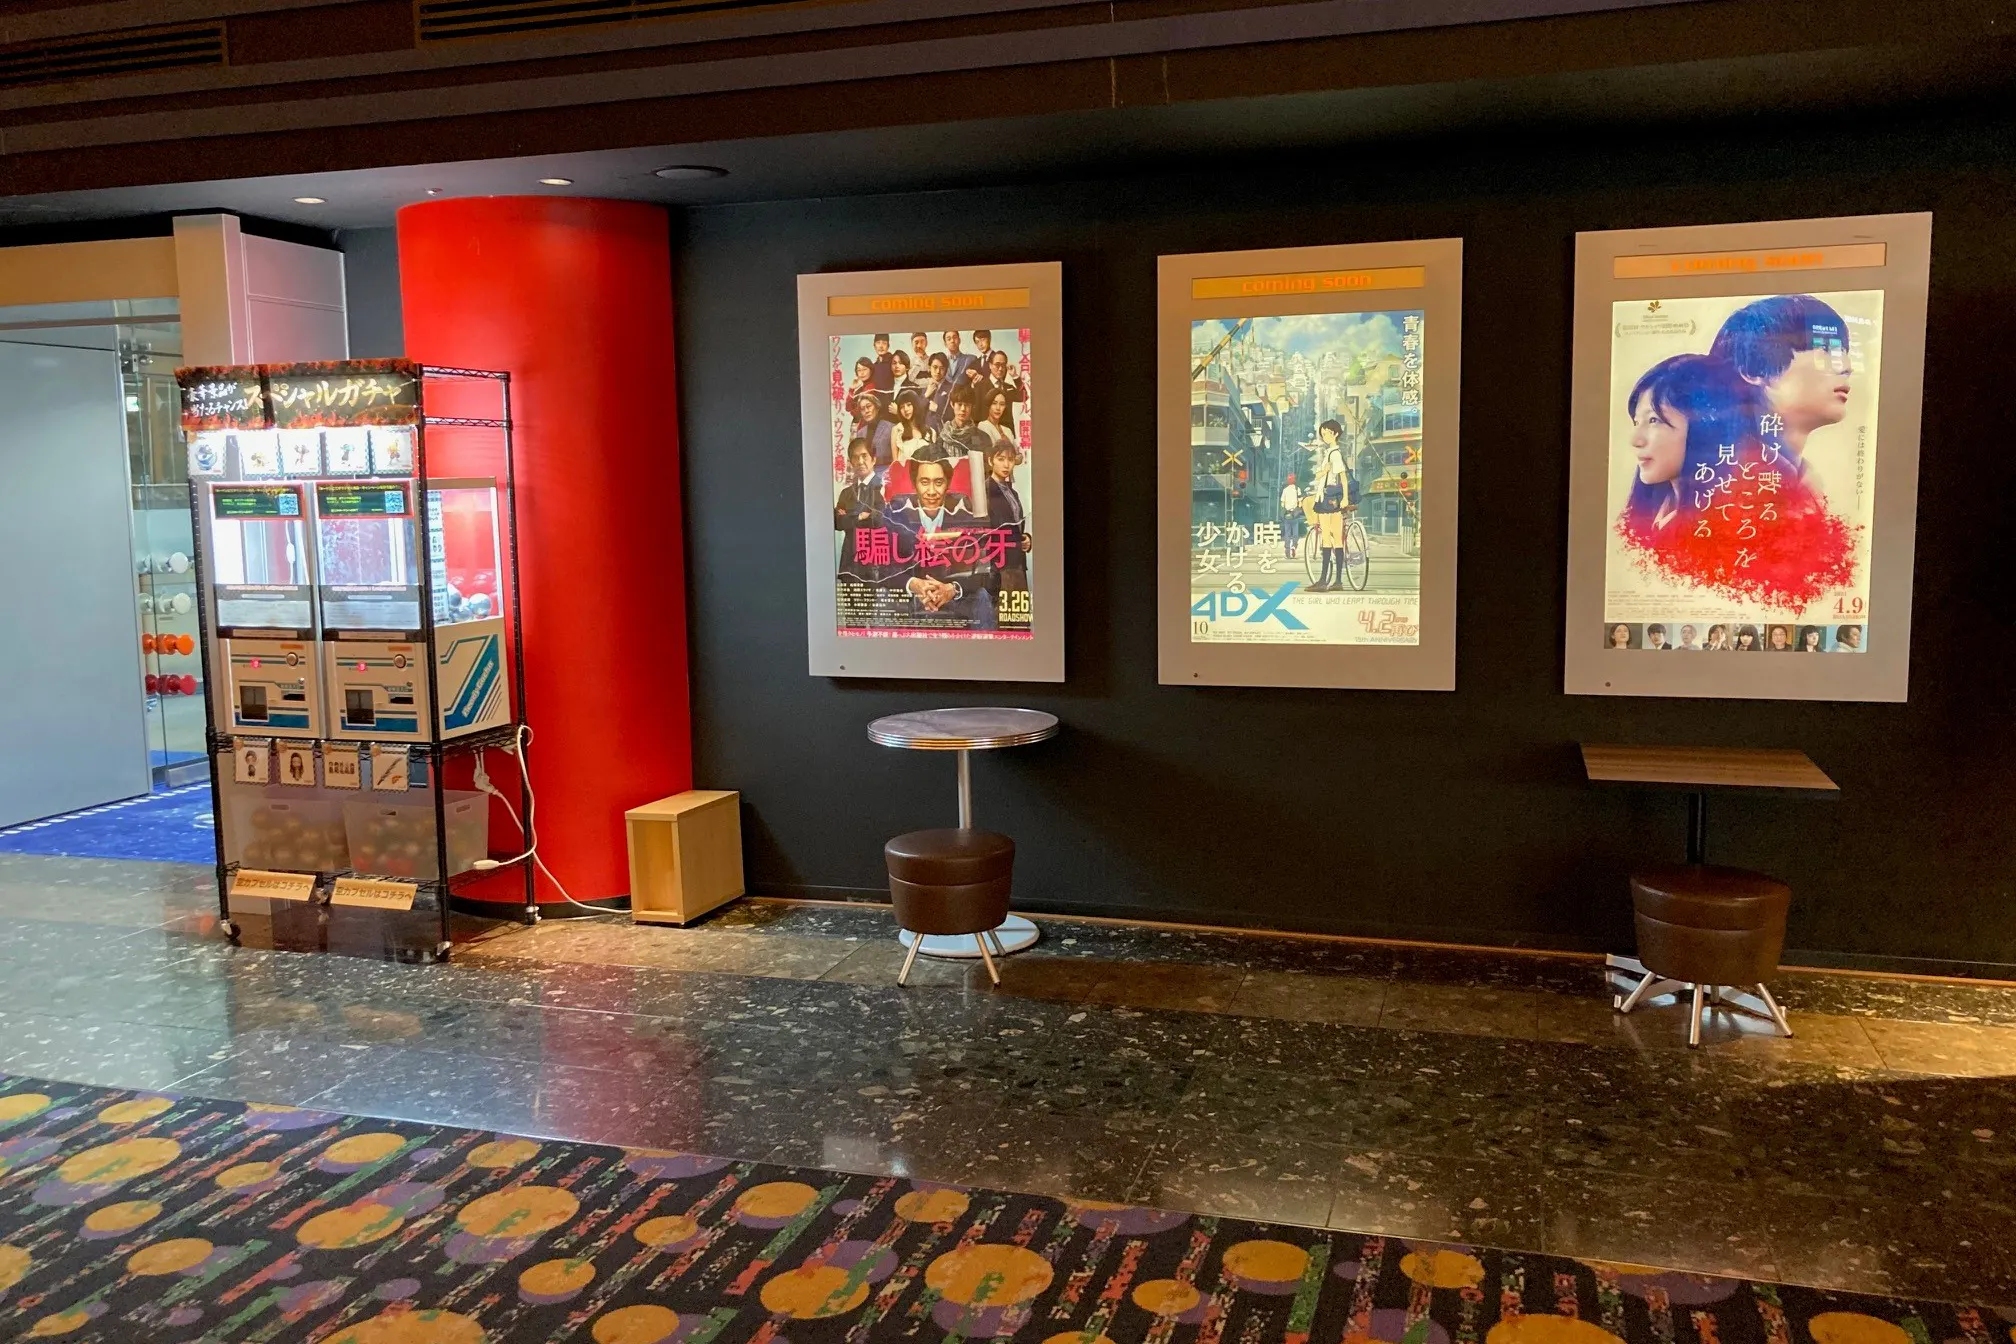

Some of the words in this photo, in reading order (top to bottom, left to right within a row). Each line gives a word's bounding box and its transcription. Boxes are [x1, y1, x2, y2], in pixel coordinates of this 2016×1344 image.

[871, 296, 935, 311] coming
[941, 294, 985, 308] soon
[1242, 276, 1316, 293] coming
[1323, 273, 1372, 289] soon
[1402, 315, 1420, 413] 青春を体感。
[1693, 462, 1716, 538] あげる
[1714, 443, 1739, 522] 見せて
[854, 526, 1017, 569] 騙し絵の牙
[1195, 521, 1221, 574] 少女
[1226, 521, 1250, 594] かける
[1253, 521, 1282, 574] 時を
[1191, 581, 1310, 630] 4DX
[1833, 597, 1864, 614] 4.9
[335, 886, 412, 900] 空カプセルはコチラへ
